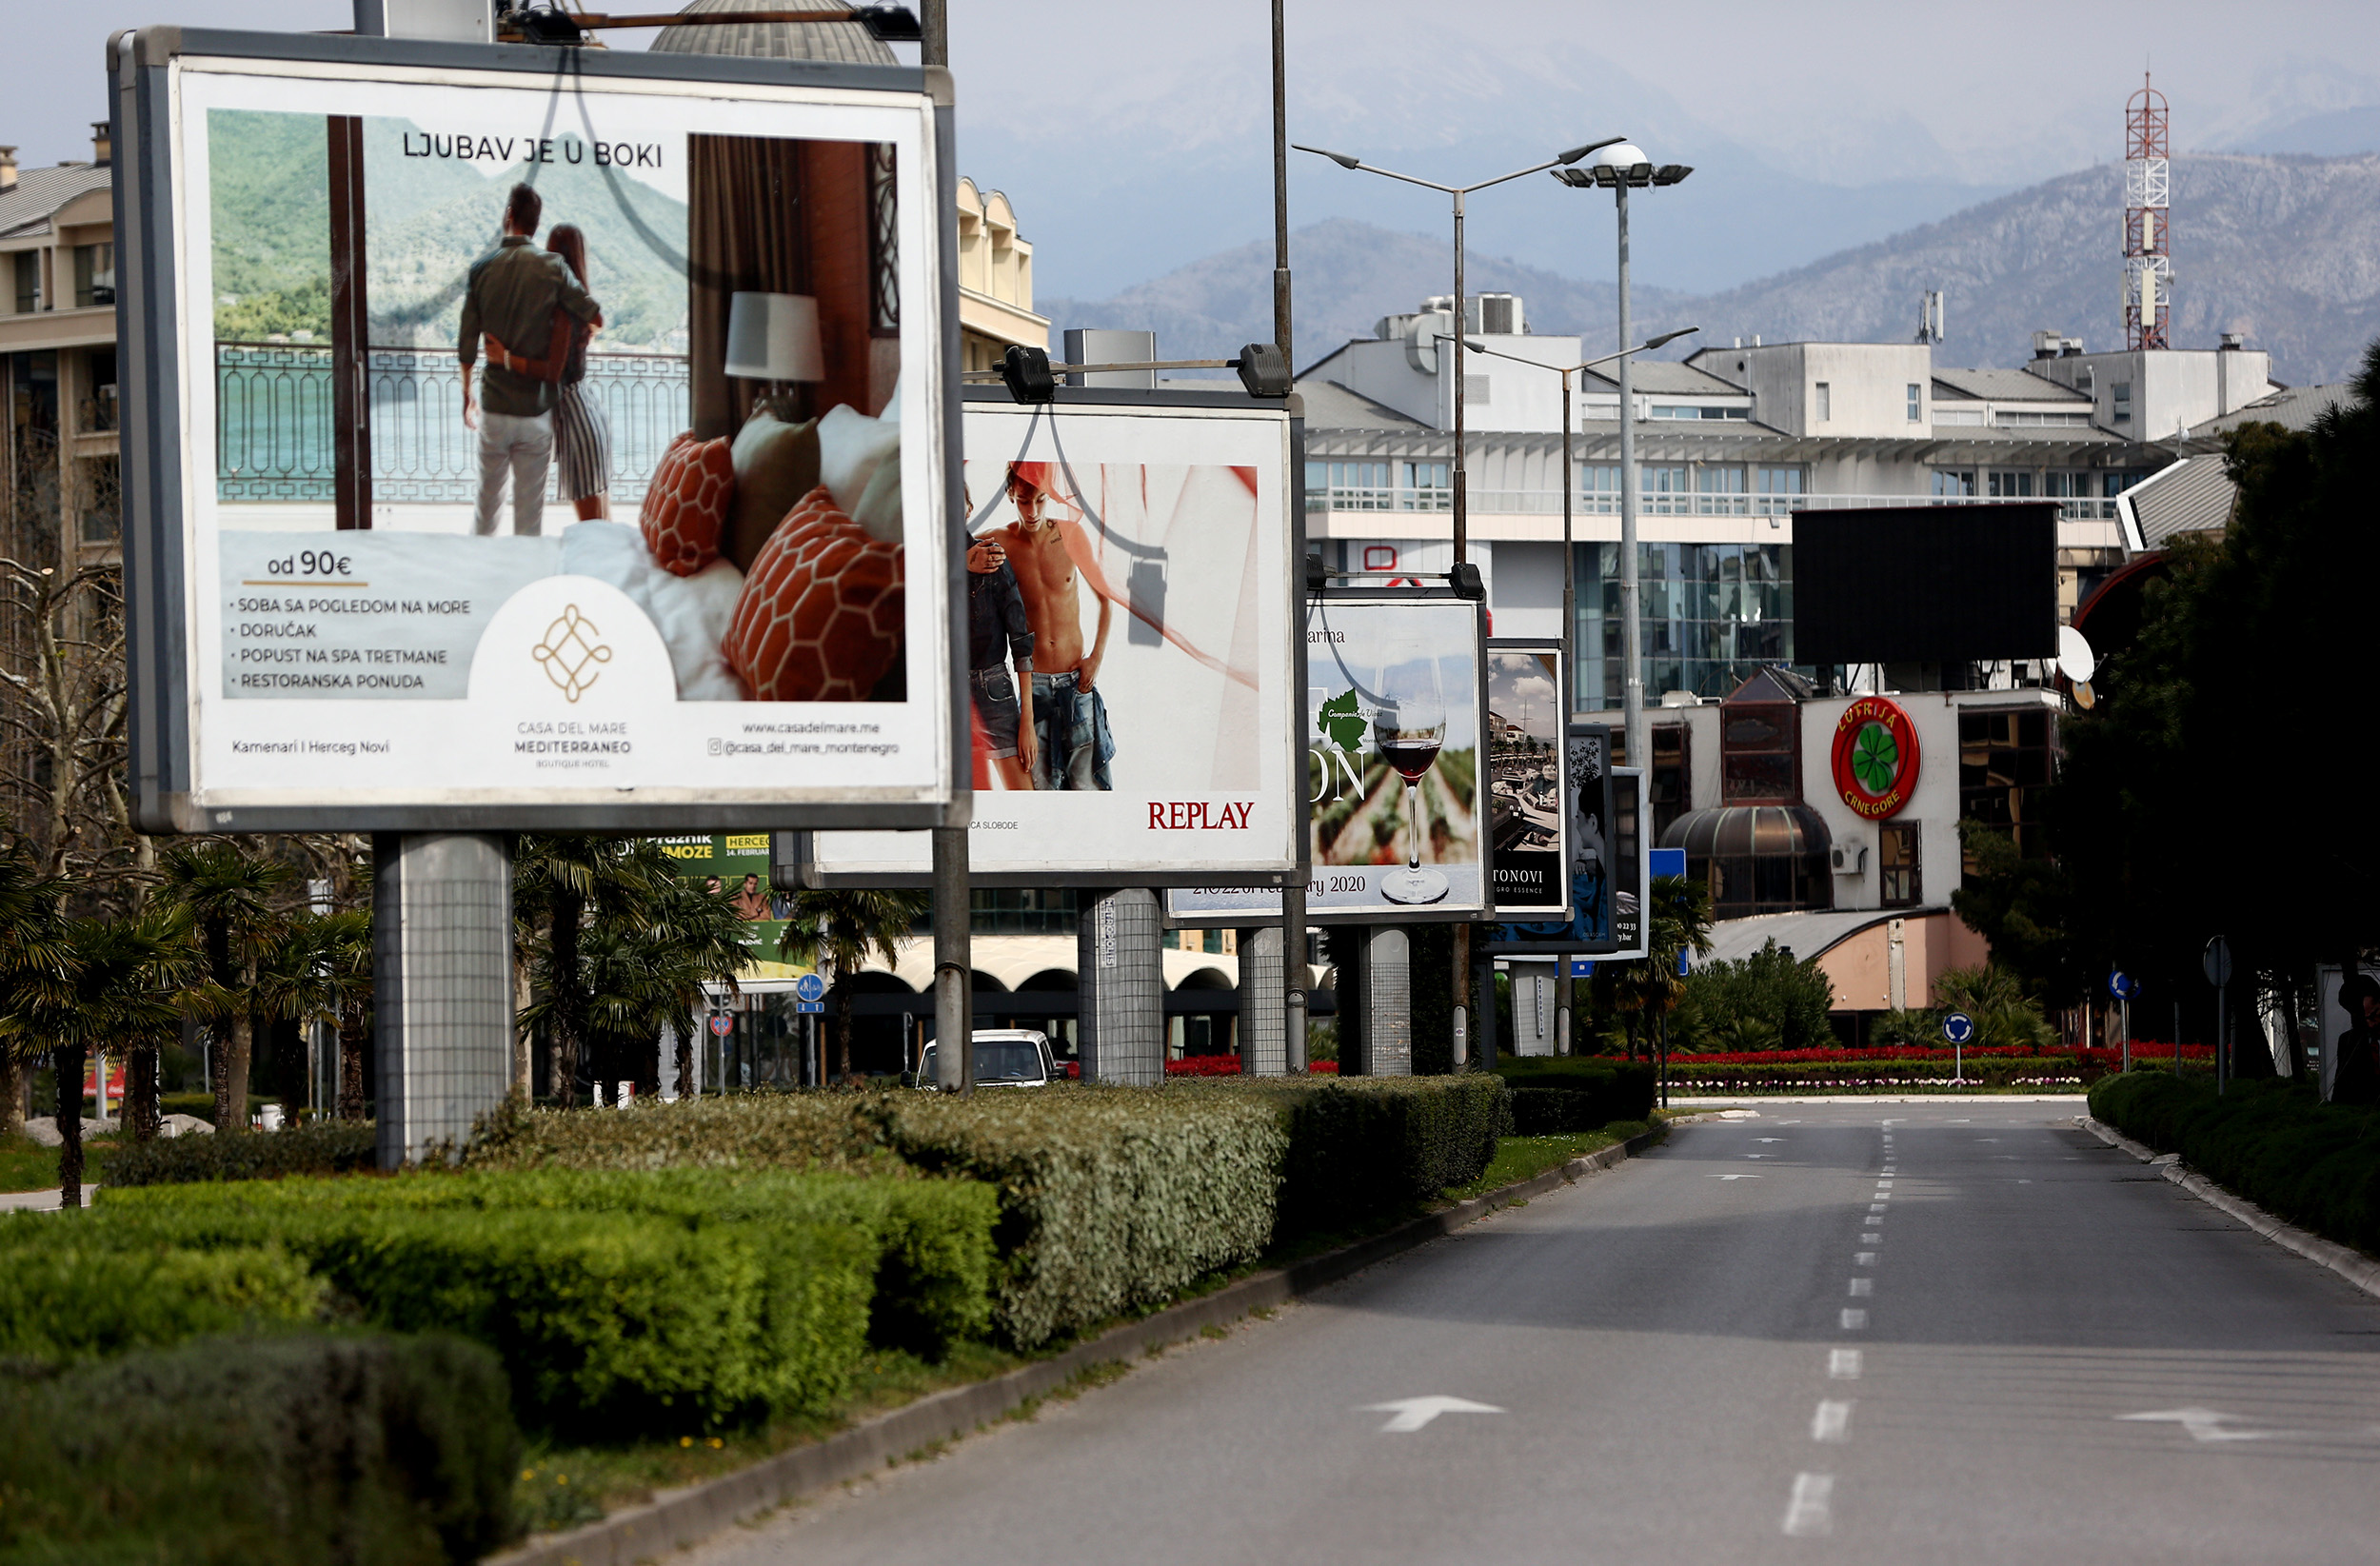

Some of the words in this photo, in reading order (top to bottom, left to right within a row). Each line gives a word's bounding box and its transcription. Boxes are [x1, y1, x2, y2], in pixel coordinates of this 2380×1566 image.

[404, 131, 514, 162] LJUBAV
[523, 137, 555, 165] JE
[565, 141, 584, 166] U
[595, 142, 663, 168] BOKI
[268, 555, 294, 575] od
[300, 549, 352, 576] 90€
[238, 599, 280, 613] SOBA
[285, 599, 305, 613] SA
[308, 599, 397, 614] POGLEDOM
[402, 600, 422, 614] NA
[427, 600, 471, 614] MORE
[240, 621, 317, 638] DORUČAK
[241, 648, 302, 663] POPUST
[307, 649, 327, 663] NA
[330, 649, 361, 664] SPA
[366, 649, 447, 664] TRETMANE
[241, 674, 353, 688] RESTORANSKA
[357, 674, 424, 688] PONUDA
[1837, 703, 1897, 732] LUTRIJA
[517, 722, 553, 734] CASA
[558, 722, 584, 734] DEL
[588, 722, 627, 734] MARE
[743, 722, 881, 734] www.casadelmare.me
[232, 740, 298, 753] Kamenari
[309, 741, 356, 756] Herceg
[360, 740, 389, 753] Novi
[514, 741, 631, 753] MEDITERRANEO
[724, 741, 901, 755] @casa_del_mare_montenegro
[1844, 790, 1871, 815] CRNE
[1871, 789, 1900, 815] GORE
[1147, 802, 1256, 830] REPLAY
[982, 821, 1019, 830] SLOBODE
[1330, 876, 1366, 893] 2020
[1105, 899, 1116, 966] METROPOLIS
